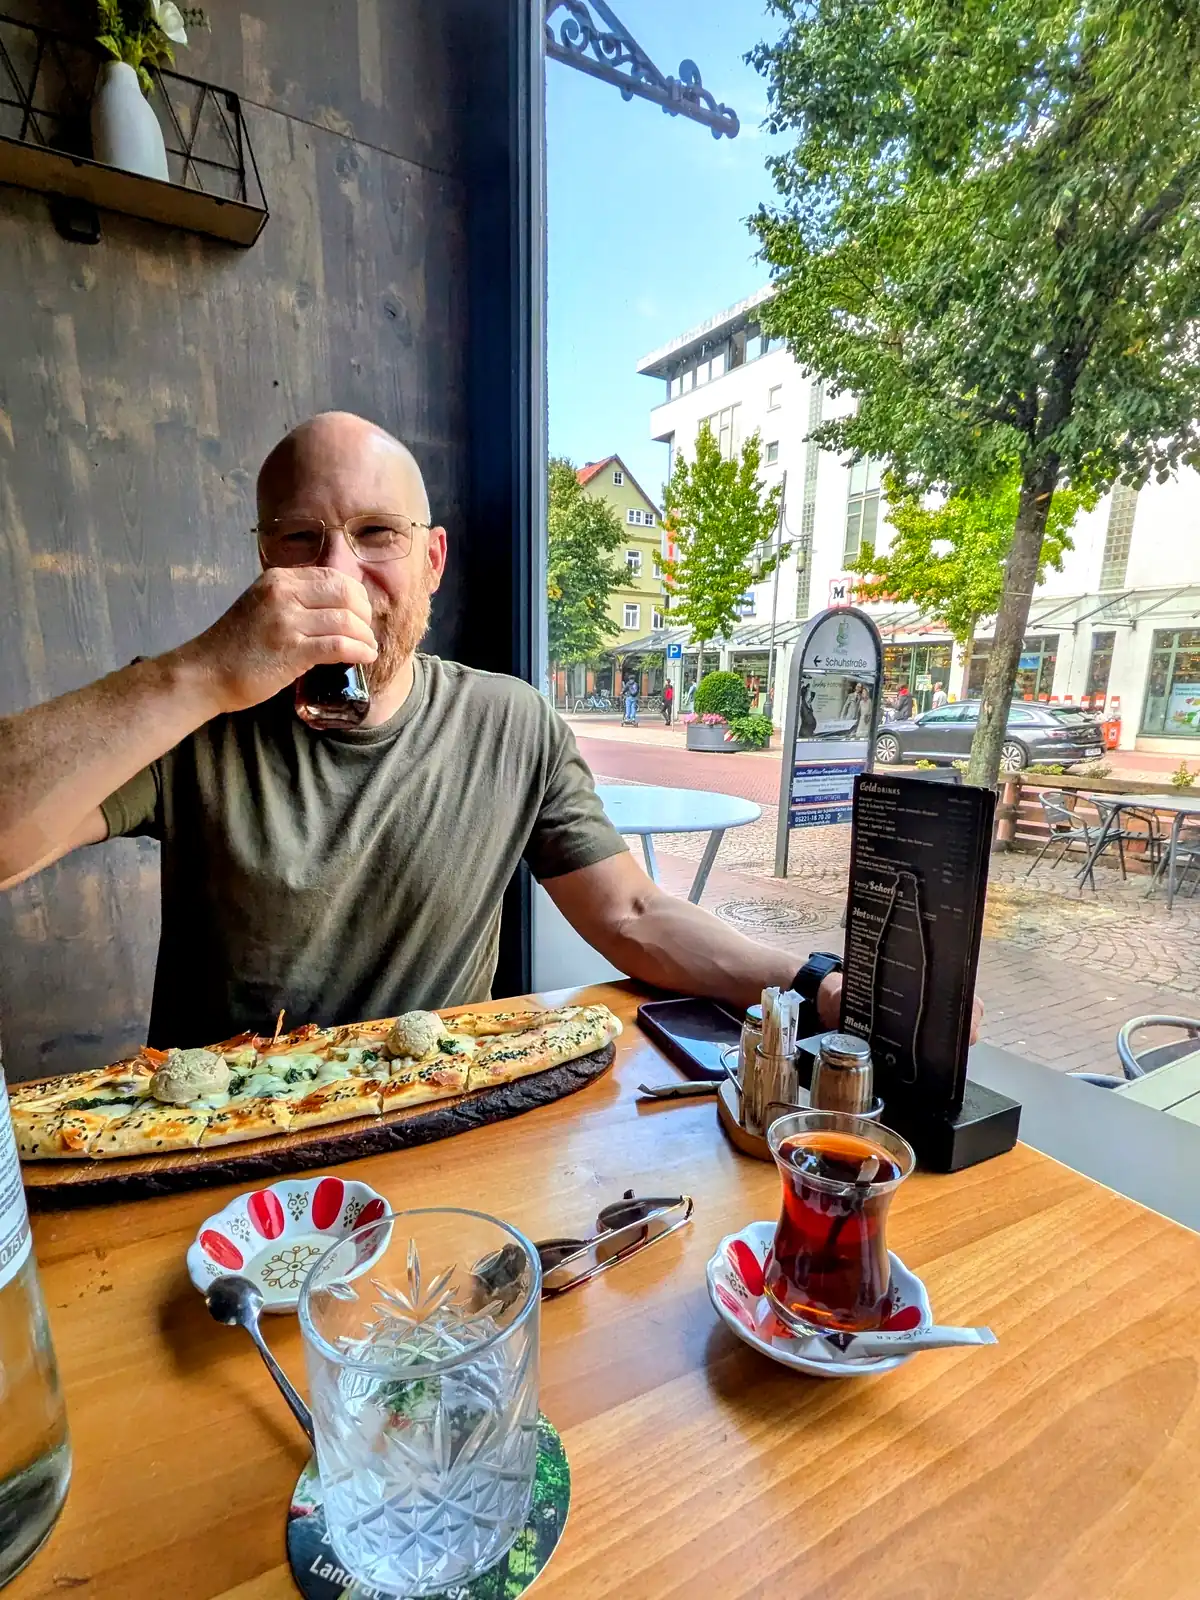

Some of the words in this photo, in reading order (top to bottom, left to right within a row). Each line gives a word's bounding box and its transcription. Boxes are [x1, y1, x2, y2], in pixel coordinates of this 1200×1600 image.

[833, 585, 845, 599] M
[670, 645, 679, 657] P
[825, 656, 868, 669] Schuhstraße
[878, 786, 901, 795] DRINKS
[876, 1328, 933, 1341] ZUCKER
